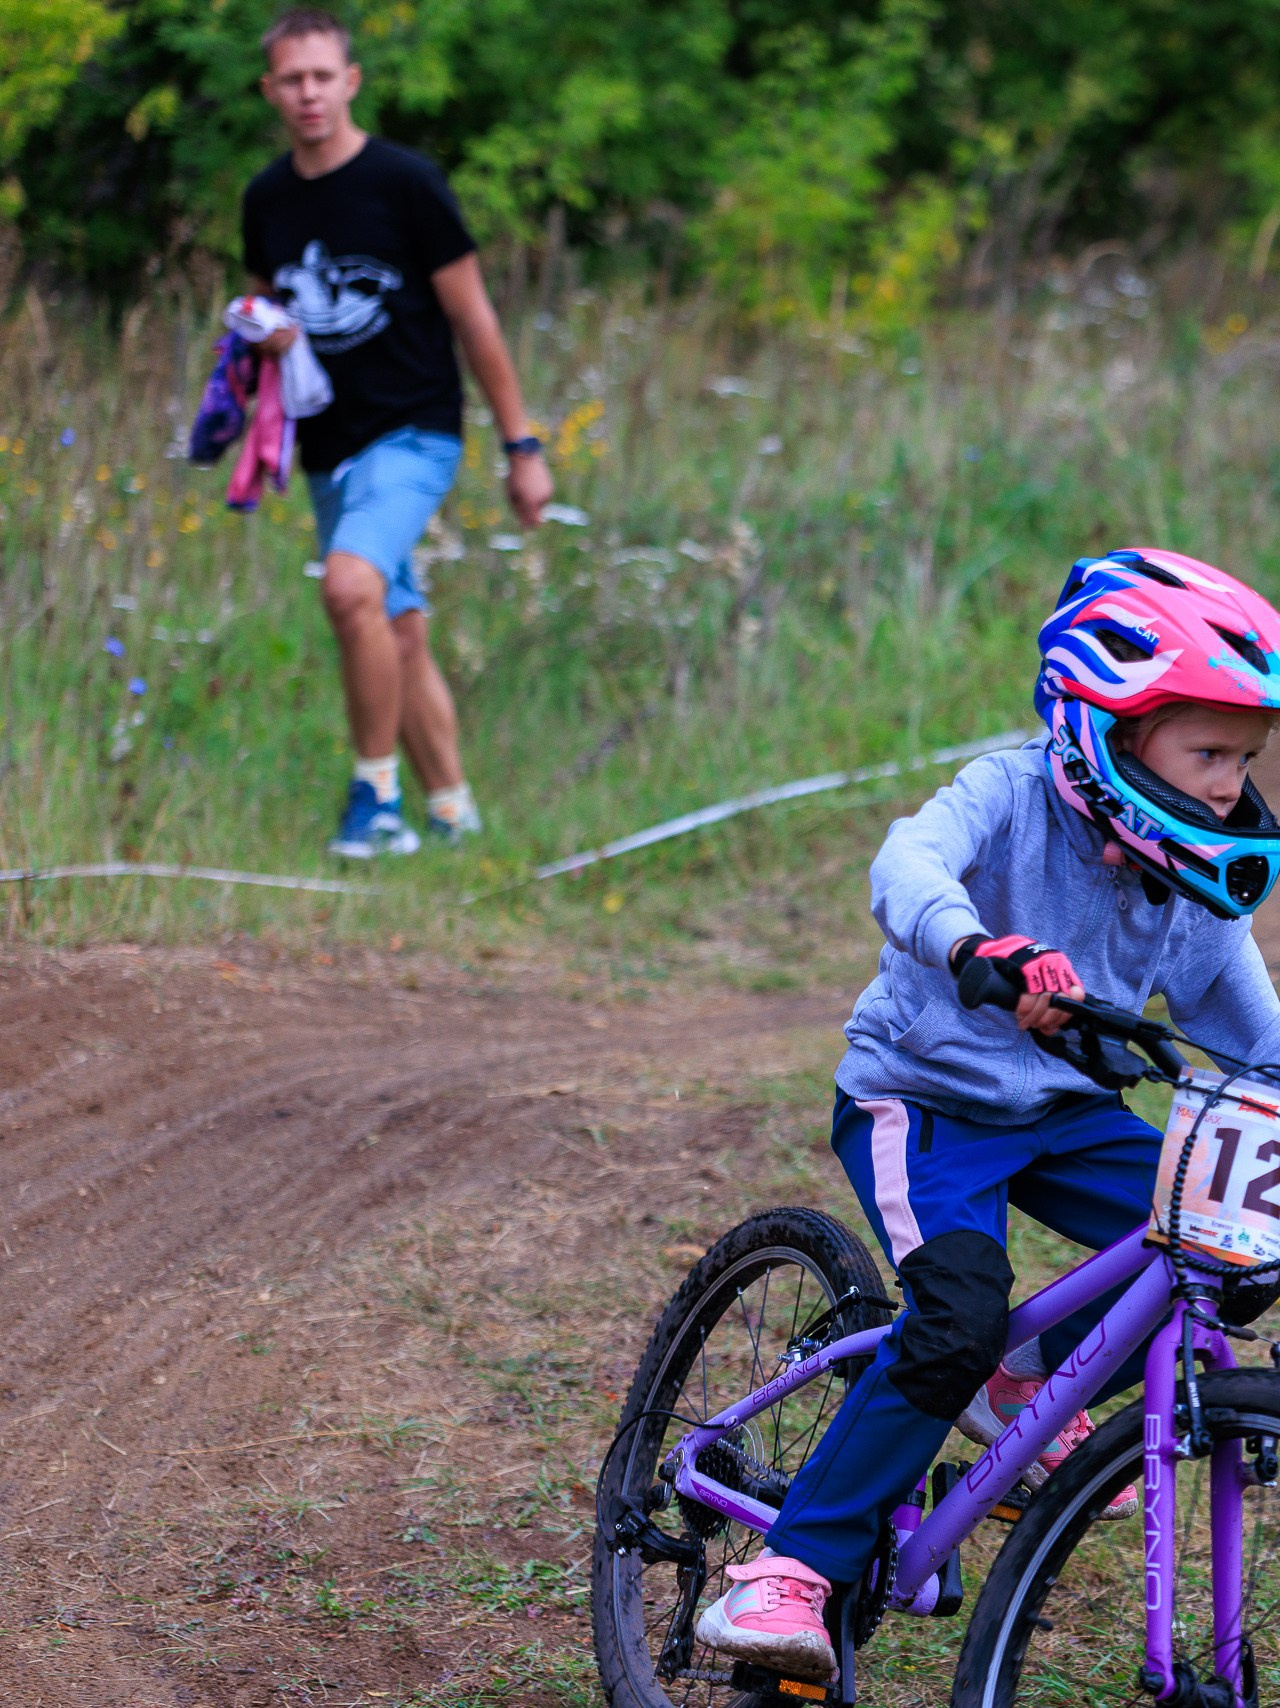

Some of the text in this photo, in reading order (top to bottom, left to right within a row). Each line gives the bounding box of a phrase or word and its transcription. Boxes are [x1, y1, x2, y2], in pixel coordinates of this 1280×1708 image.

[753, 1354, 820, 1405] BRYNO
[699, 1489, 728, 1508] BRYNO
[1144, 1414, 1161, 1610] BRYNO
